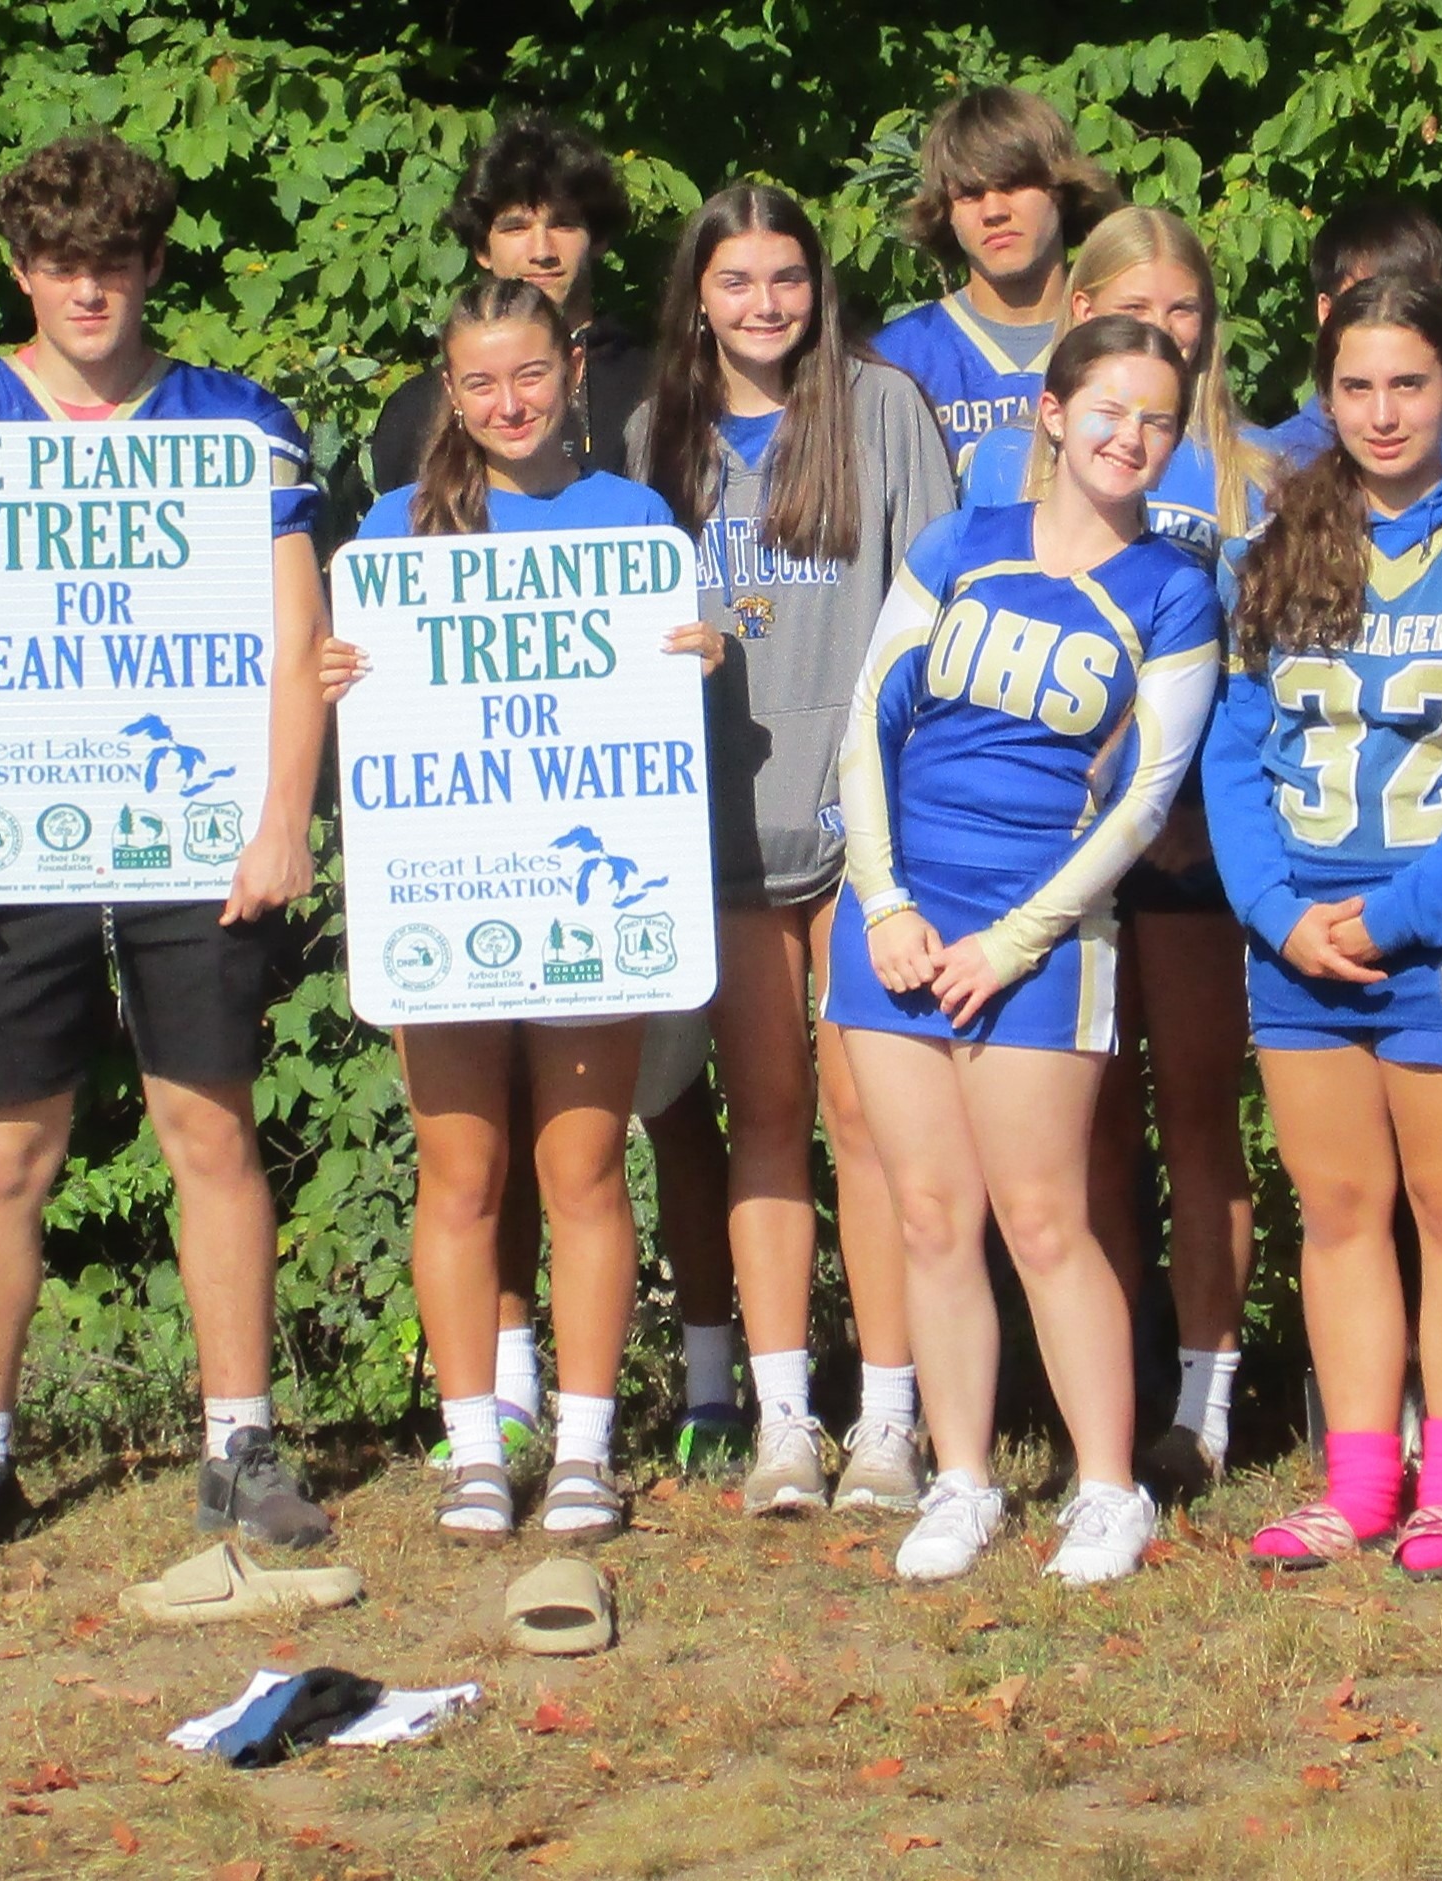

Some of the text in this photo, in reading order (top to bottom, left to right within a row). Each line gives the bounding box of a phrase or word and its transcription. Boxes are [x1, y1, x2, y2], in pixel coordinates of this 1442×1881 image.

[28, 434, 257, 490] PLANTED
[346, 539, 681, 607] WE PLANTED
[55, 581, 134, 626] FOR
[101, 633, 267, 689] WATER
[417, 608, 617, 686] TREES
[927, 598, 1120, 736] OHS
[481, 693, 561, 740] FOR
[46, 738, 132, 760] Lakes
[352, 740, 698, 811] CLEAN WATER
[38, 853, 91, 865] Arbor Day
[38, 863, 93, 872] Foundation
[387, 852, 562, 880] Great Lakes
[389, 876, 574, 904] RESTORATION
[468, 970, 522, 981] Arbor Day
[468, 980, 524, 990] Foundation
